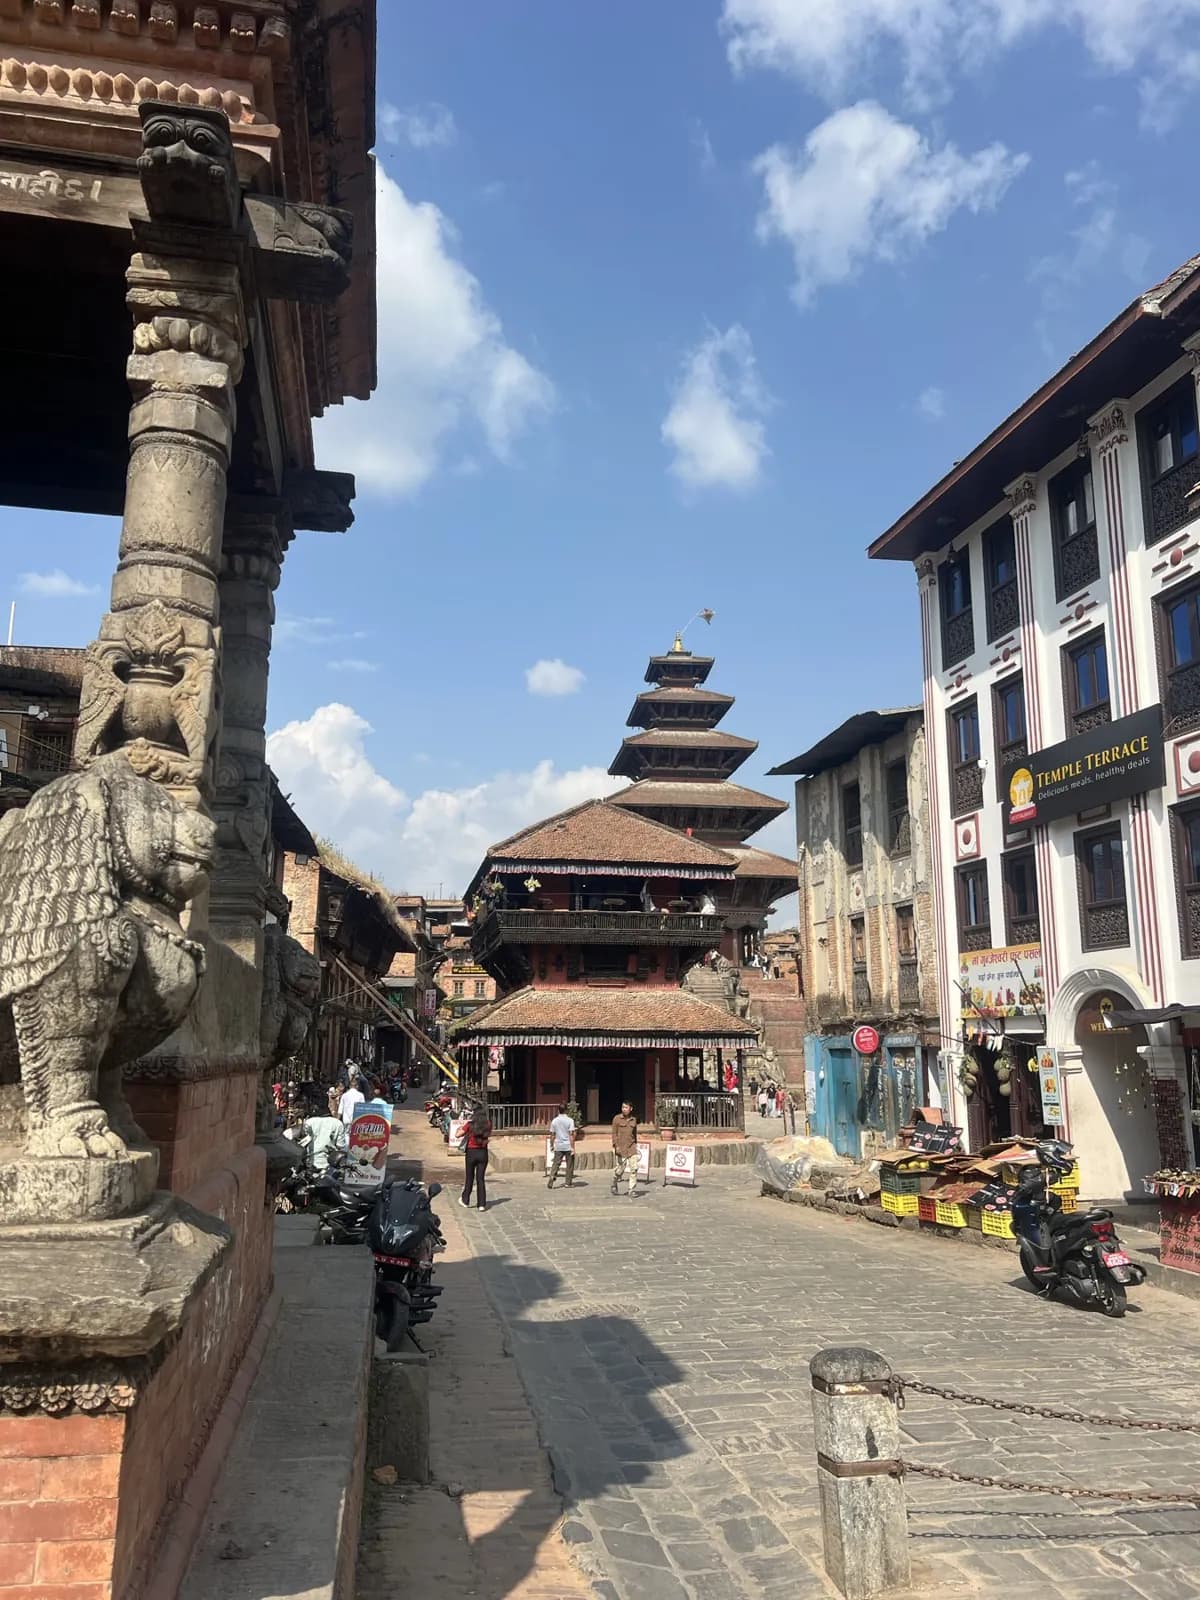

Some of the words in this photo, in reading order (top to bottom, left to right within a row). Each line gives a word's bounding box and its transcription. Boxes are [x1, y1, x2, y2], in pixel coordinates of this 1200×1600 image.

[1036, 760, 1082, 788] TEMPLE
[1085, 736, 1149, 770] TERRACE
[1038, 784, 1069, 800] Delicious
[1095, 765, 1125, 781] healthy
[1128, 756, 1150, 770] deals
